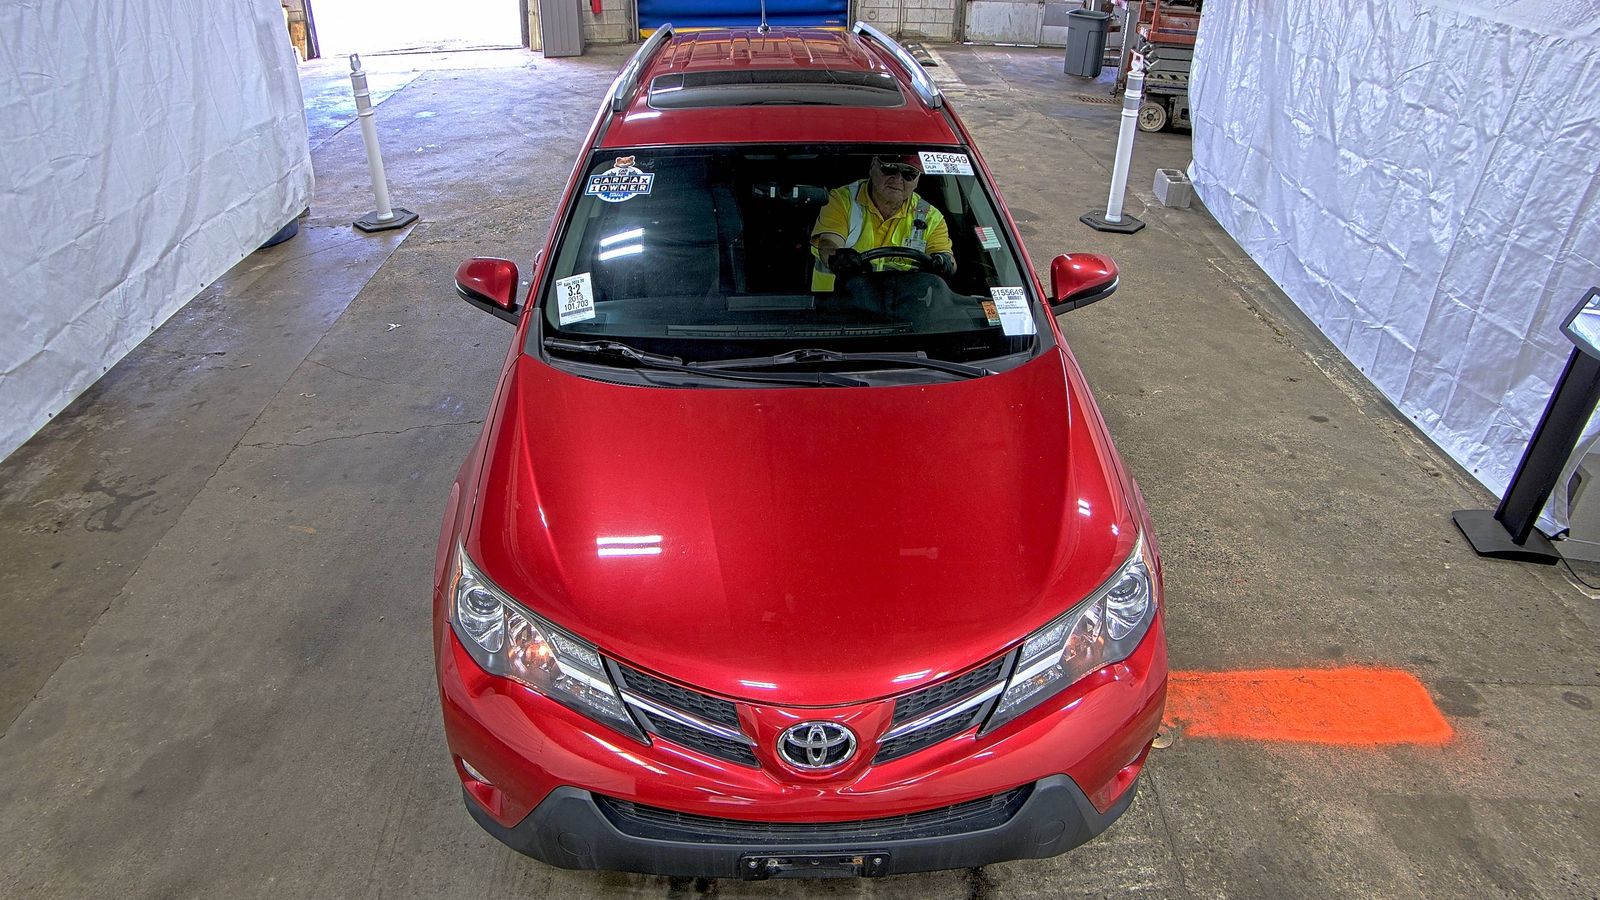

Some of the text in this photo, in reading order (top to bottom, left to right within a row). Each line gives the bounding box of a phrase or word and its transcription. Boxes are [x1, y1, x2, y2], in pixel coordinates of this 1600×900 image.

[923, 153, 968, 164] 2155649
[568, 284, 581, 296] 3:2
[568, 294, 584, 303] 2013
[564, 300, 589, 311] 101,703
